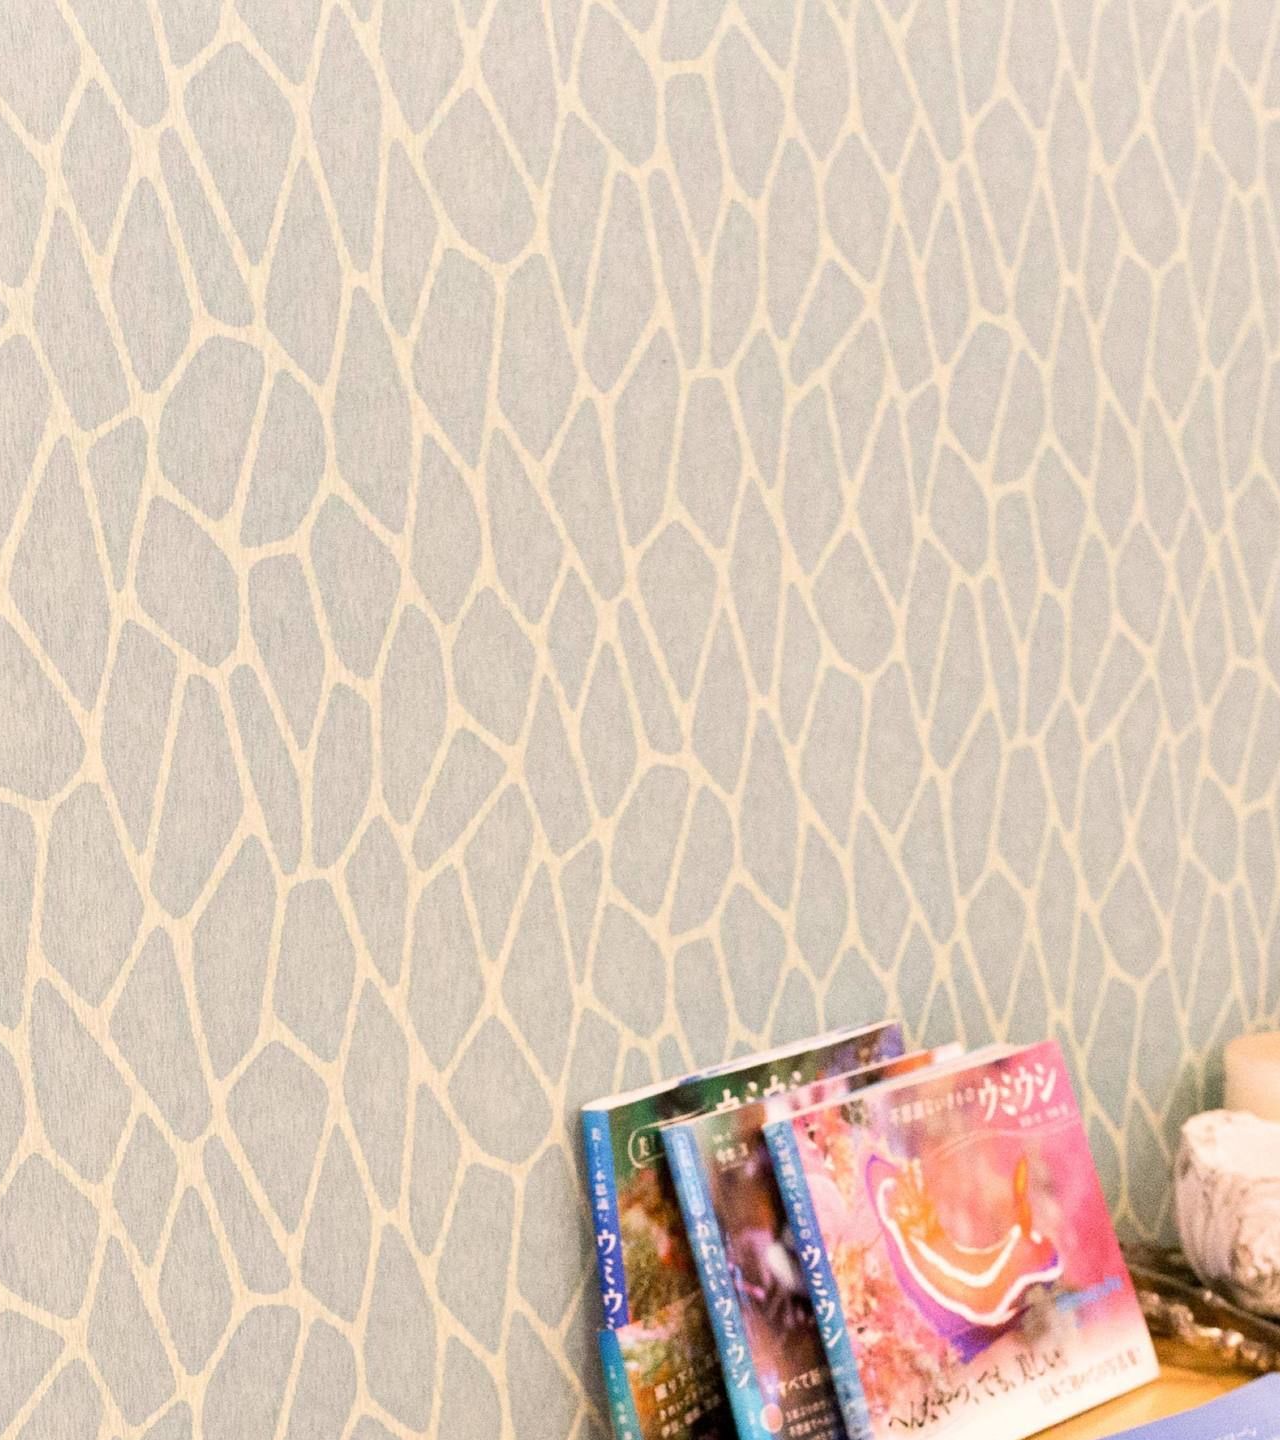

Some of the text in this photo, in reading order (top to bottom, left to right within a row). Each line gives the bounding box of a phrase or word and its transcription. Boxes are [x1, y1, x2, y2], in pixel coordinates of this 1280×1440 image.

[979, 1062, 1058, 1121] ウミウシ
[800, 1244, 844, 1350] ウミウシ
